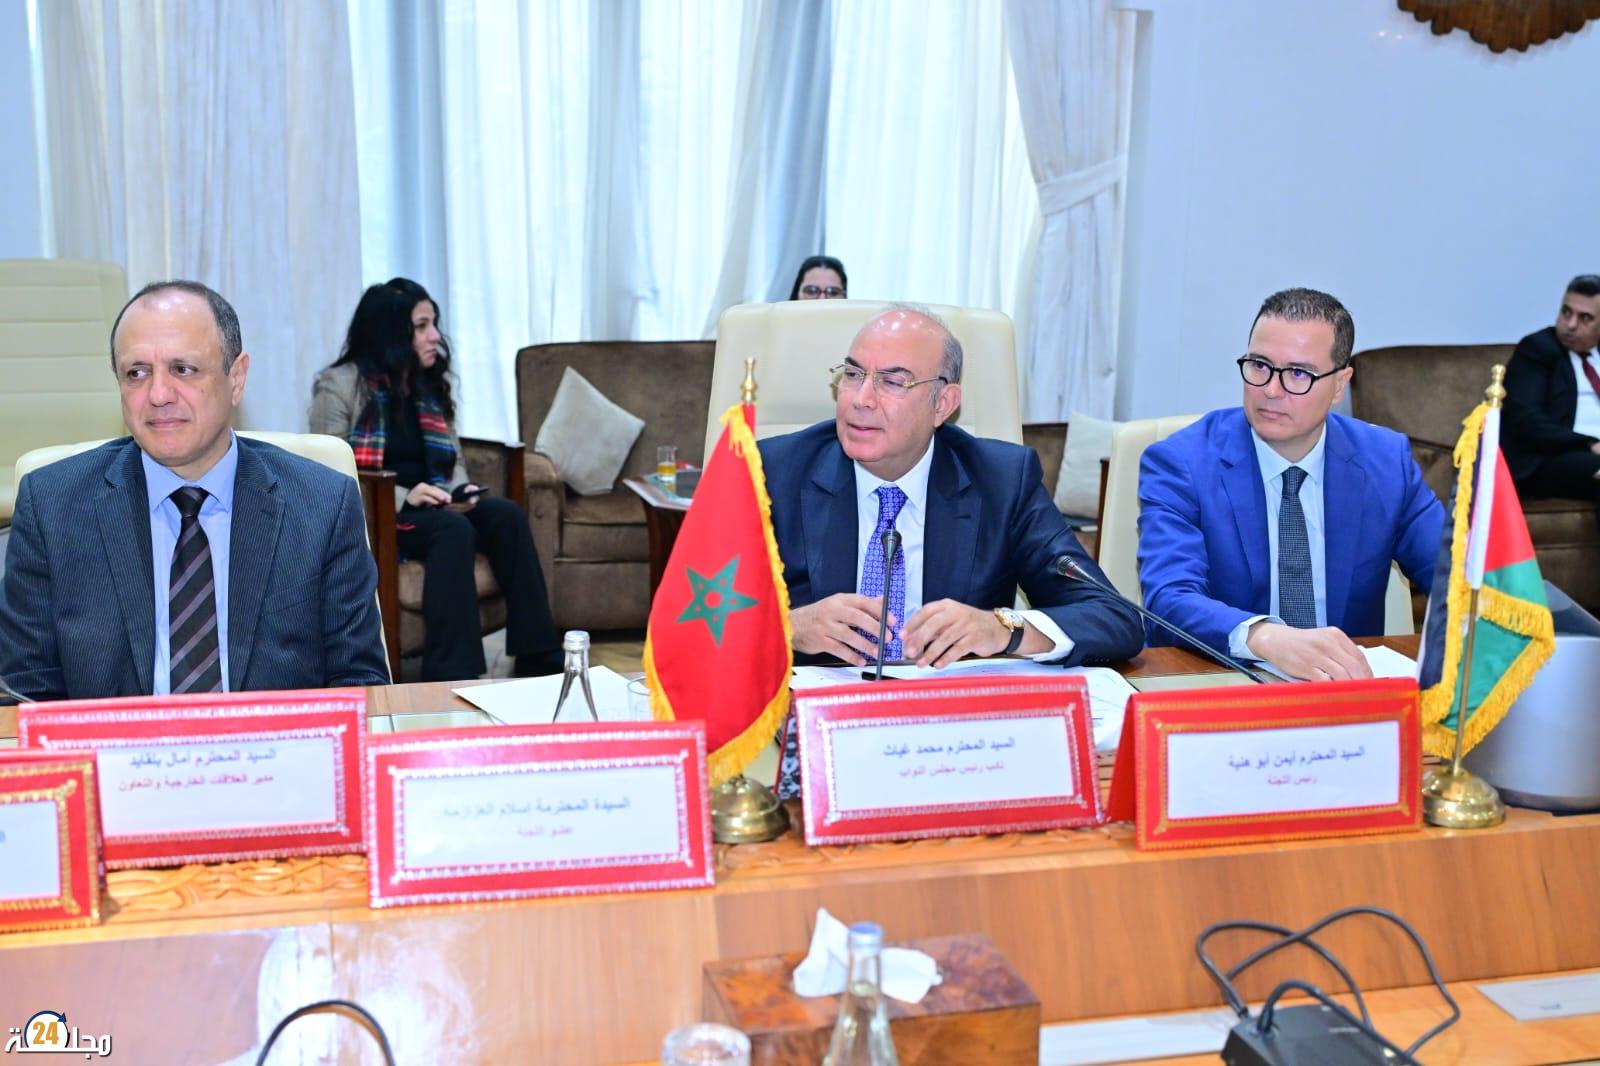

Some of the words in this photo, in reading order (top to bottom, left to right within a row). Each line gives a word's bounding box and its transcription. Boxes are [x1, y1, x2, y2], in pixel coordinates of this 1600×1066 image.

[917, 744, 943, 754] محمد
[947, 738, 985, 755] المحترم
[991, 736, 1015, 752] السيد
[196, 750, 240, 767] المحترم
[248, 748, 276, 763] السيد
[1300, 748, 1336, 766] المحترم
[1341, 745, 1364, 761] السيد
[930, 762, 956, 776] مجلس
[960, 764, 982, 775] رئيس
[165, 775, 205, 788] الخارجية
[210, 773, 247, 785] العلاقات
[536, 798, 588, 815] المحترمة
[594, 796, 630, 813] السيدة
